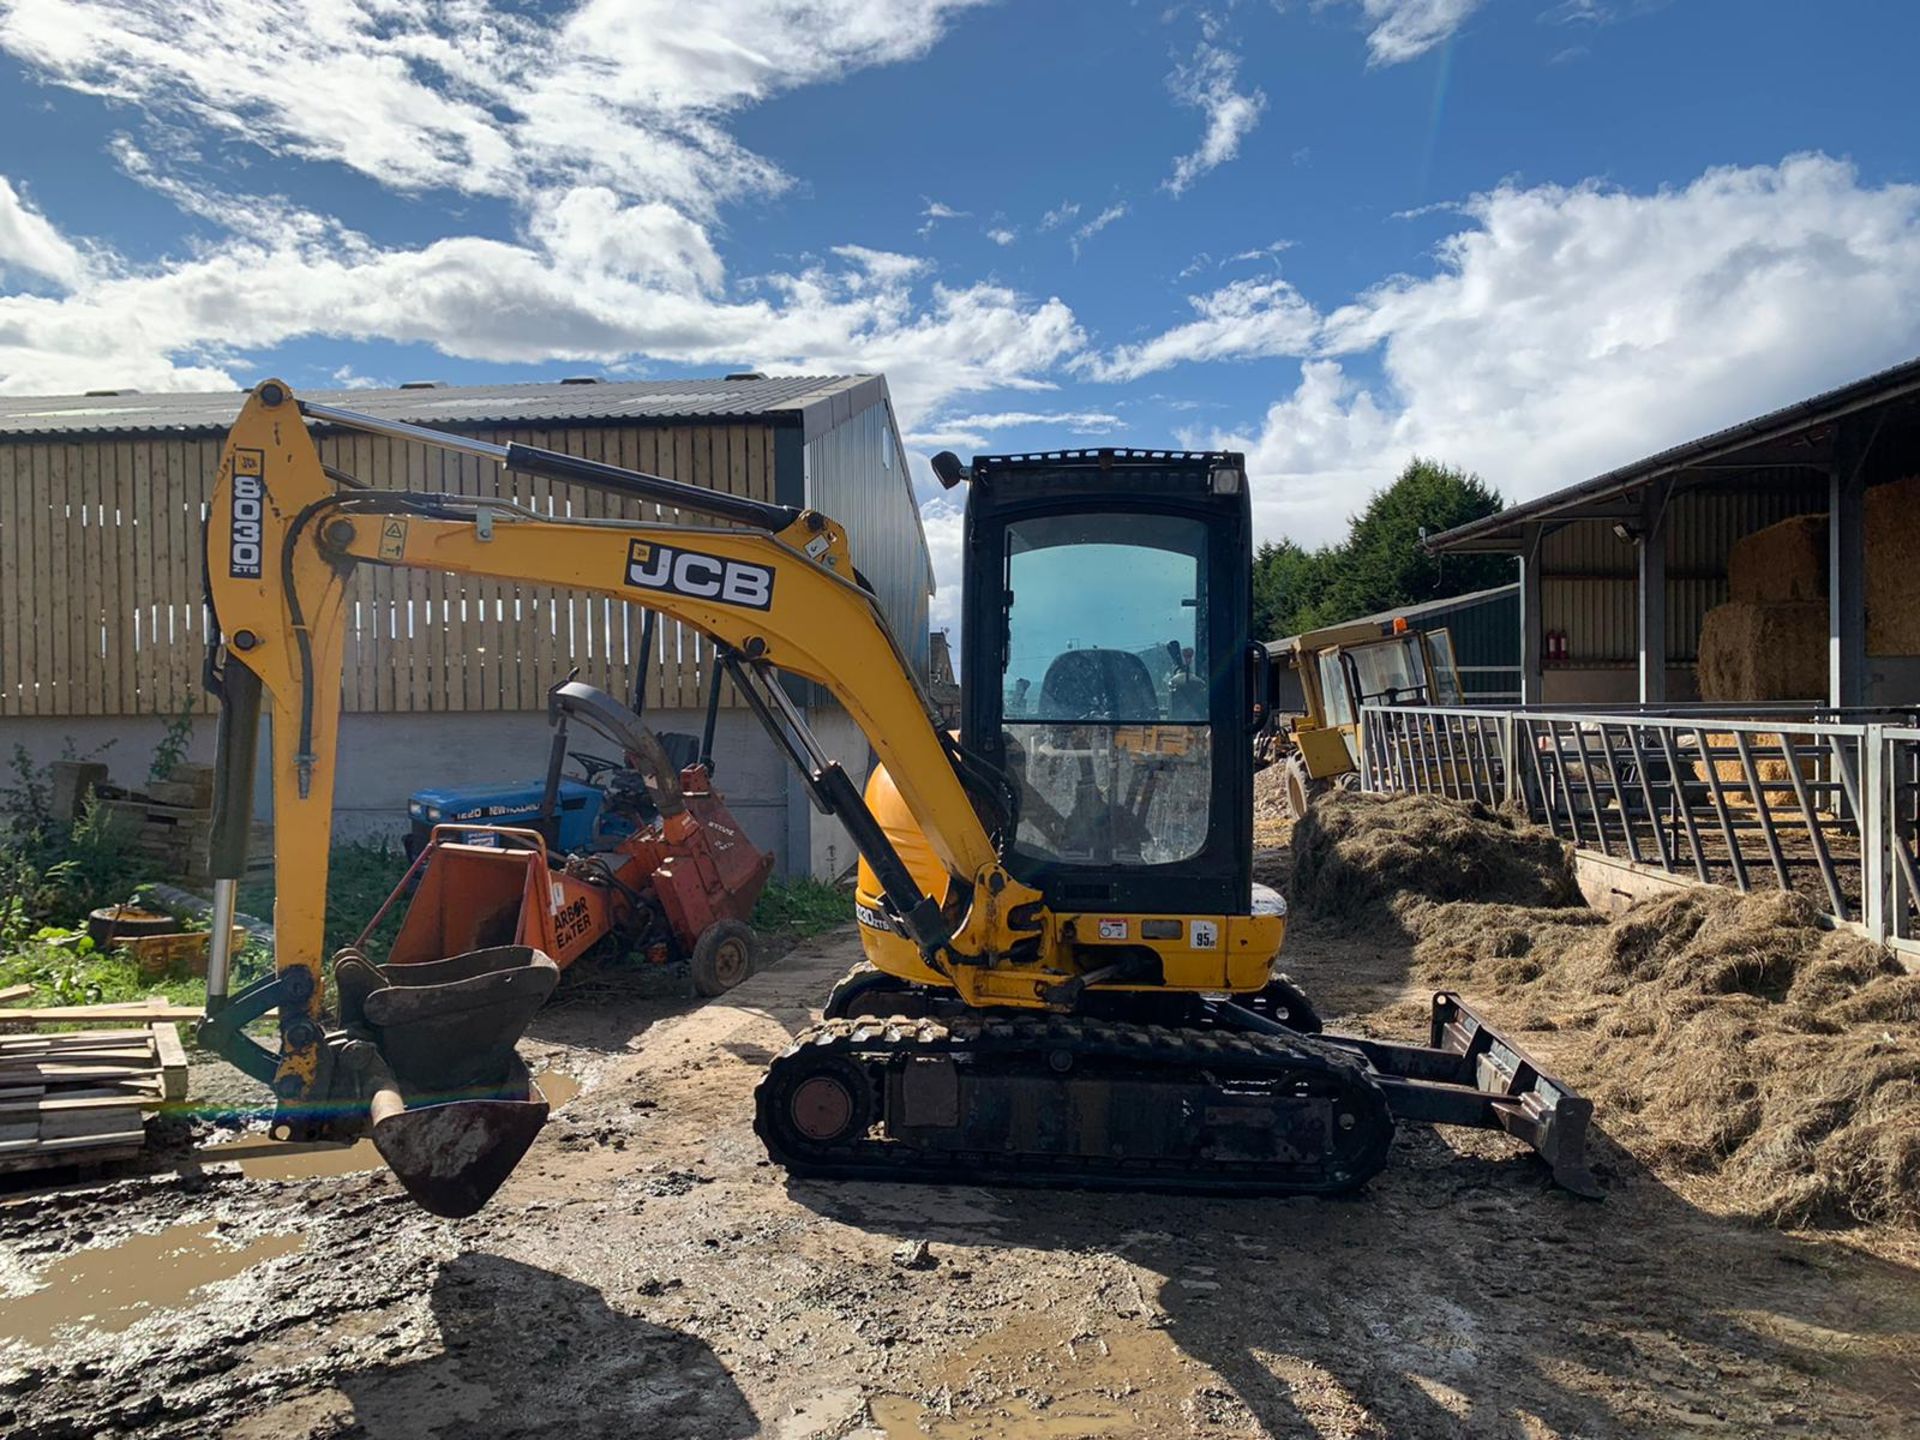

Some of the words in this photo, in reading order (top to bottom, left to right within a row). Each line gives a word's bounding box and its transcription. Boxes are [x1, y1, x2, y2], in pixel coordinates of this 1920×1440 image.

[233, 475, 261, 565] 8030
[629, 548, 770, 606] JCB
[554, 896, 589, 933] ARBOR
[556, 913, 592, 950] EATER
[1197, 933, 1209, 946] 95
